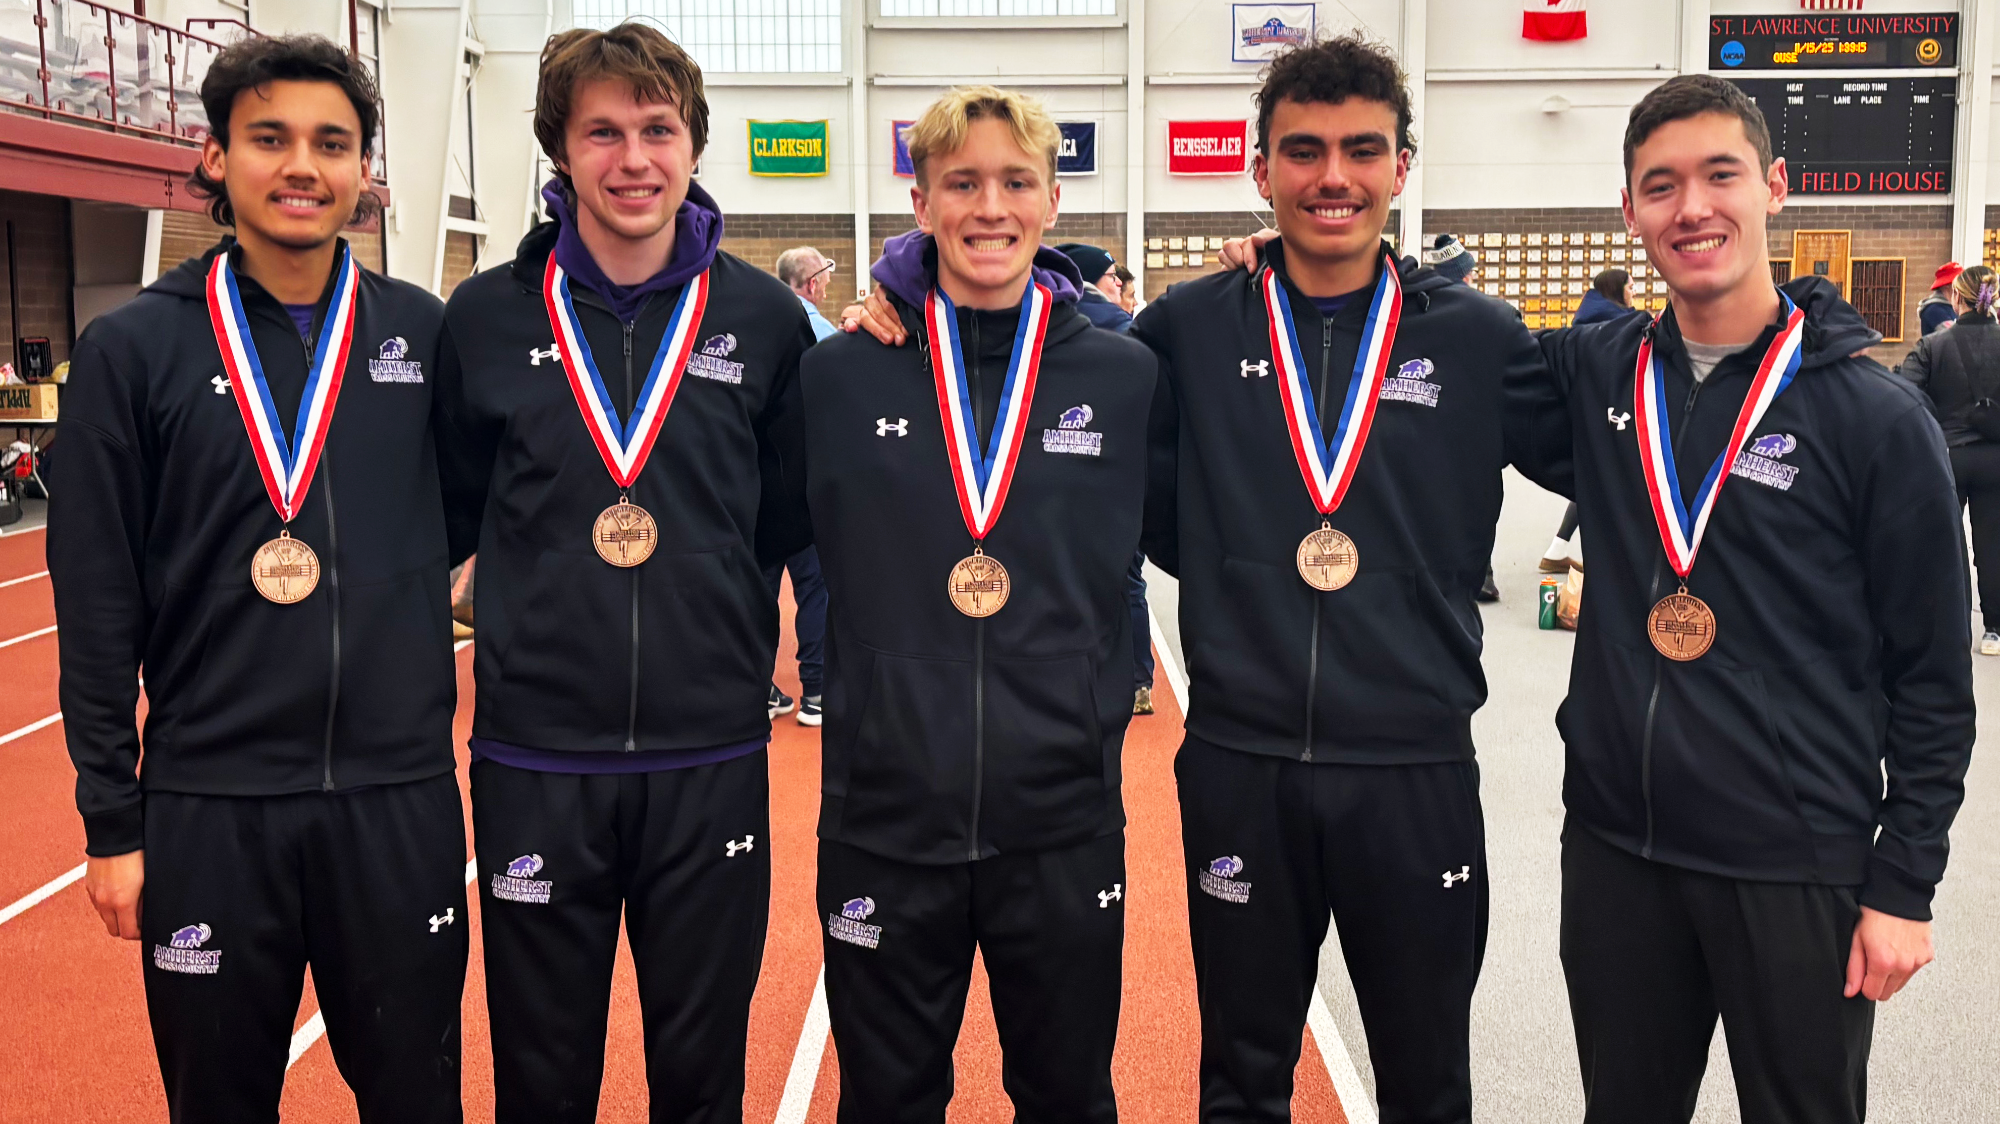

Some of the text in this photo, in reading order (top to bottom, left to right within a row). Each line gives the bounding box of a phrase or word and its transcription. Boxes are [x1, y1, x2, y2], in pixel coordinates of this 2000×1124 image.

[1711, 16, 1954, 35] ST. LAWRENCE UNIVERSITY
[1773, 52, 1798, 63] OUSE
[1786, 83, 1804, 92] HEAT
[1843, 82, 1888, 92] RECORD TIME
[1787, 96, 1804, 105] TIME
[1833, 94, 1930, 105] LANE PLACE TIME
[753, 137, 822, 157] CLARKSON
[1173, 136, 1242, 157] RENSSELAER
[1801, 172, 1861, 192] FIELD
[1868, 171, 1946, 192] HOUSE
[1042, 428, 1103, 448] AMHERST
[1544, 591, 1555, 604] G
[491, 873, 553, 895] AMHERST
[153, 944, 222, 965] AMHERST
